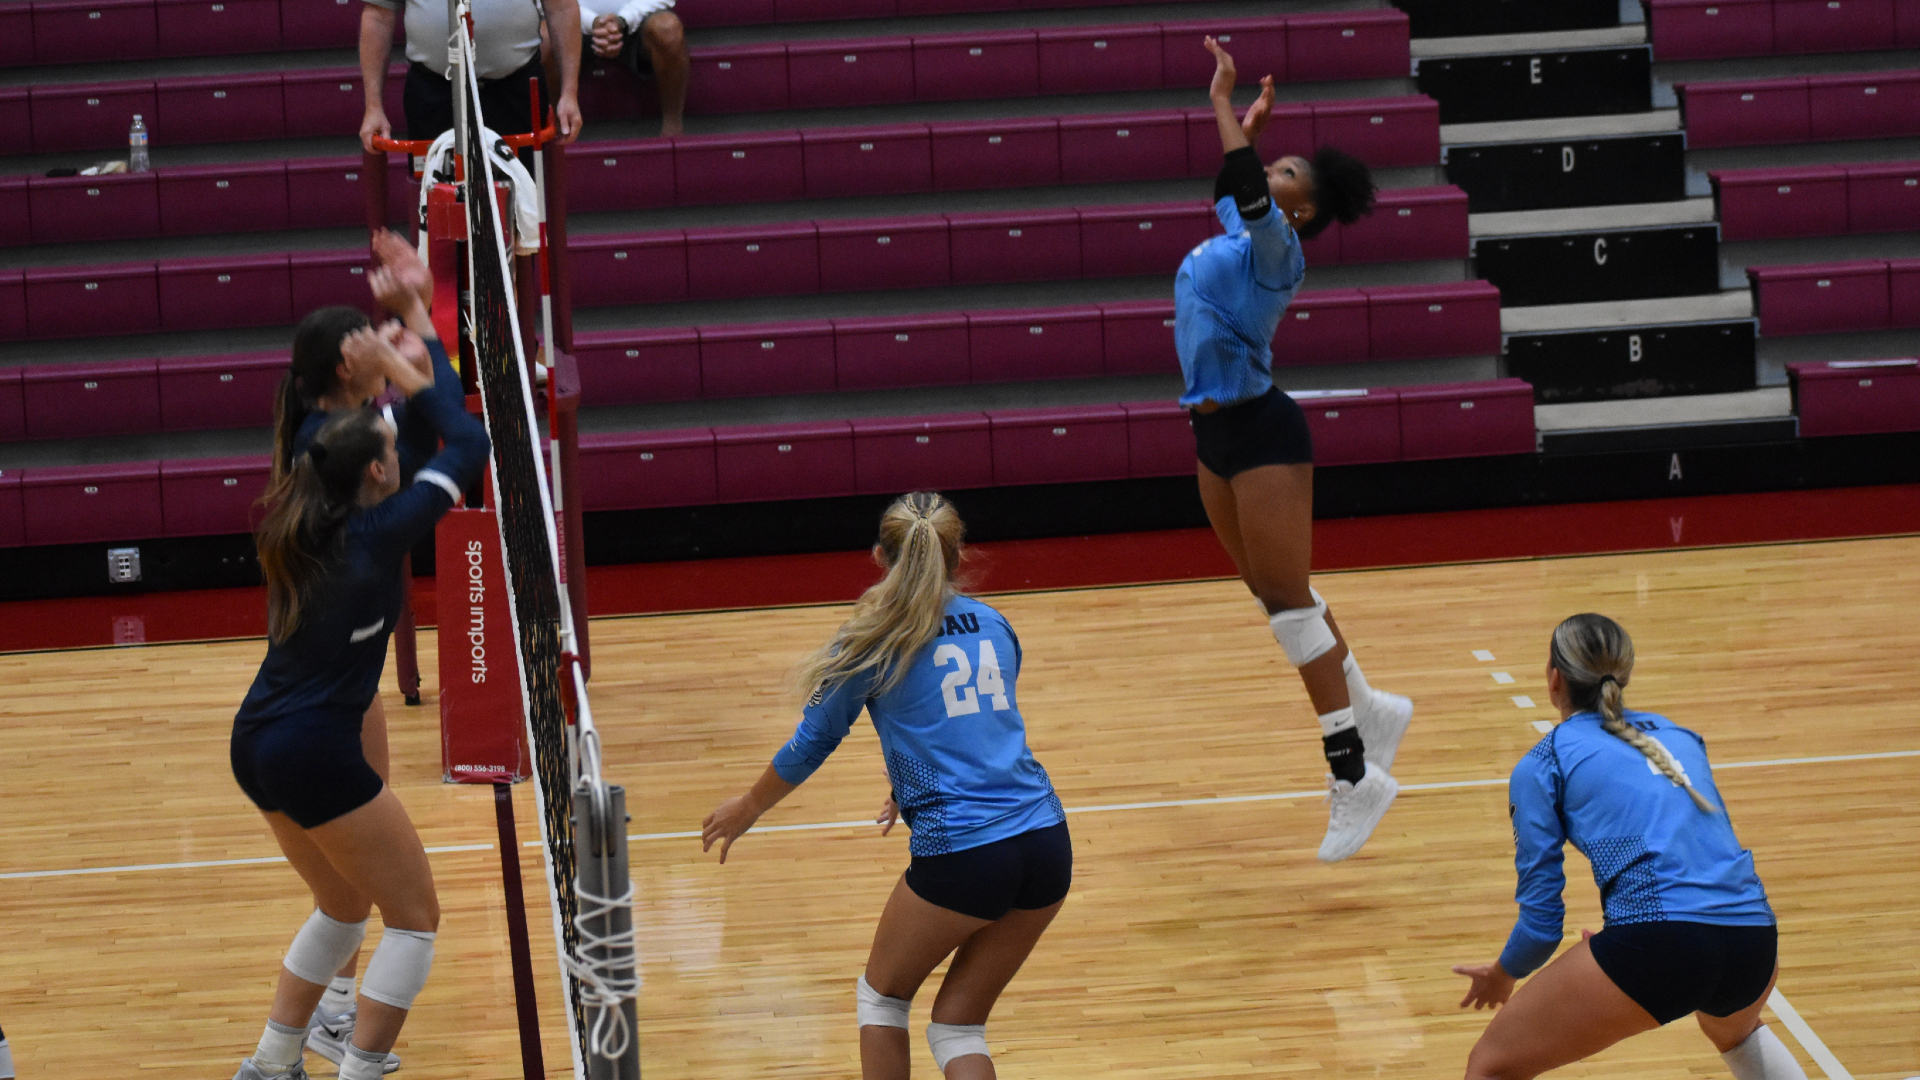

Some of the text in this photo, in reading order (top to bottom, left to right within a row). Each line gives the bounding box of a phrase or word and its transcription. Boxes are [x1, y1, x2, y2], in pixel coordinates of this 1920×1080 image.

[1530, 58, 1541, 84] E
[1562, 146, 1575, 172] D
[1594, 238, 1606, 265] C
[1629, 336, 1641, 362] B
[1669, 453, 1682, 480] A
[465, 540, 487, 684] sports imports
[933, 640, 1010, 718] 24
[454, 764, 506, 773] (800) 556-3198
